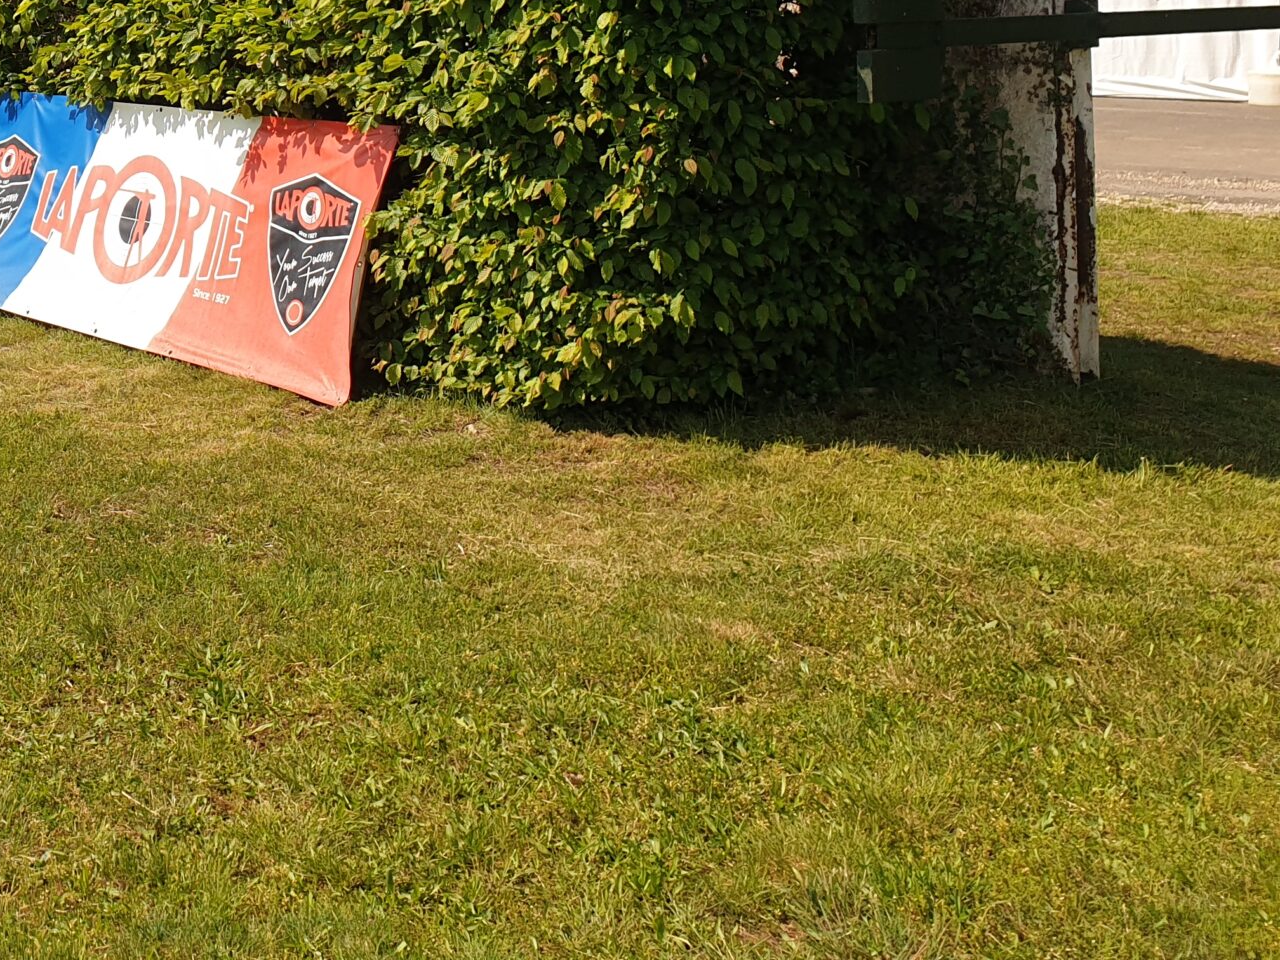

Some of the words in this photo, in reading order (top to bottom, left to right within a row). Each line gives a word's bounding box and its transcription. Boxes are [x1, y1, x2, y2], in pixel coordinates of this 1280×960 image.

[31, 155, 250, 284] LAPORTE
[275, 185, 351, 231] LAPORTE
[273, 248, 297, 285] Your
[298, 245, 334, 273] Success
[278, 275, 297, 302] Our
[298, 266, 335, 298] Target
[211, 293, 231, 305] 1927
